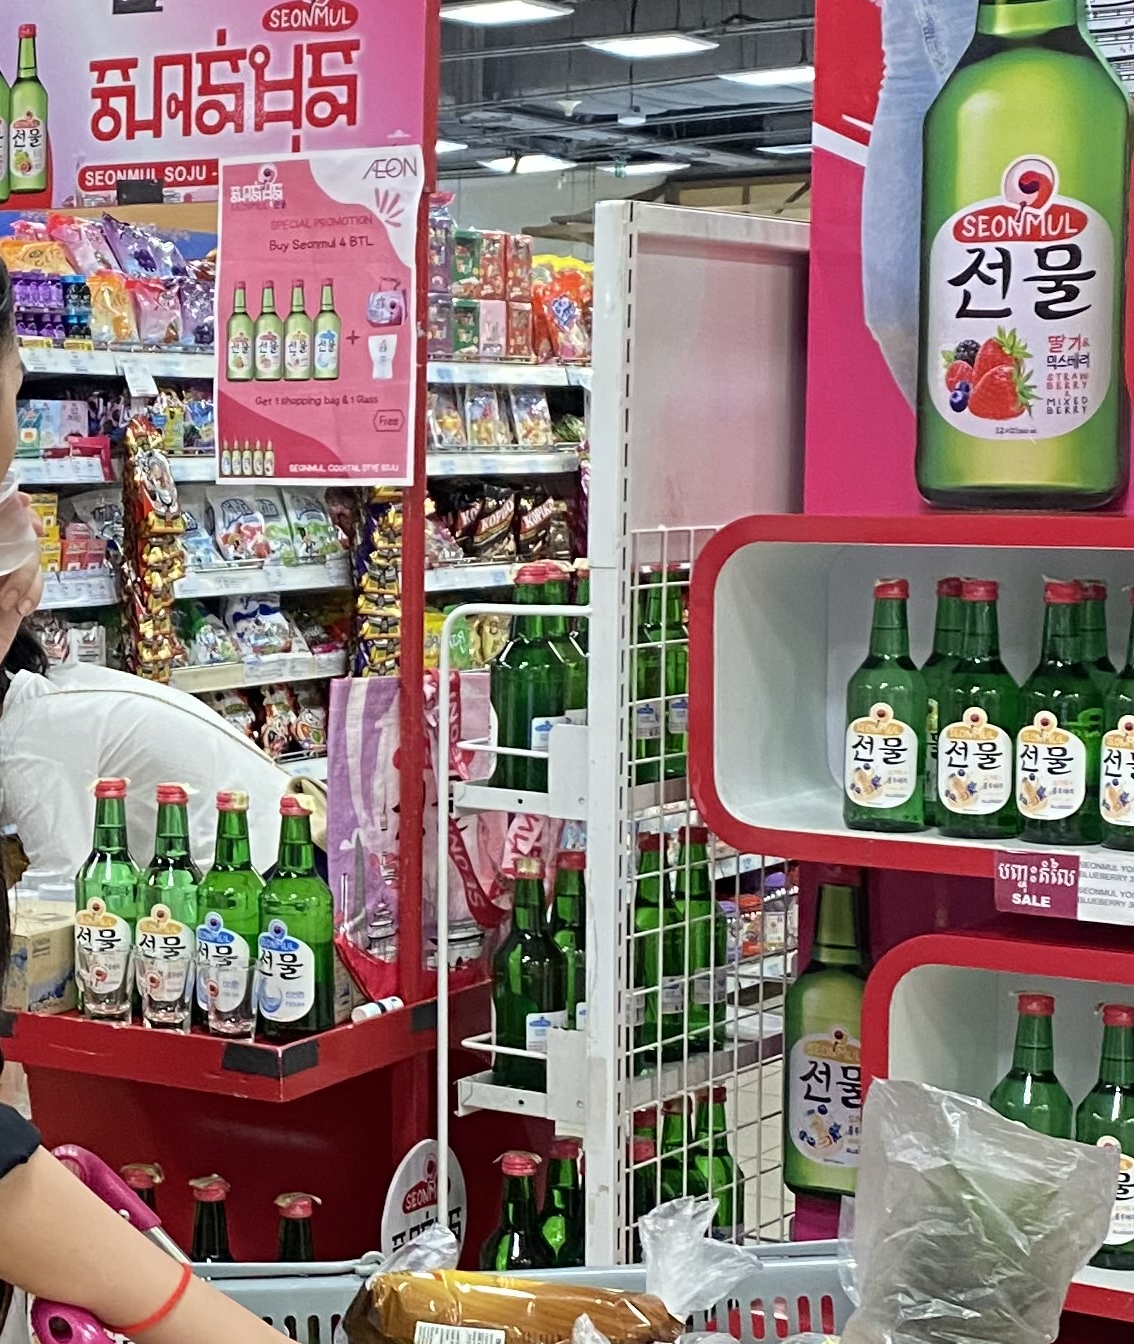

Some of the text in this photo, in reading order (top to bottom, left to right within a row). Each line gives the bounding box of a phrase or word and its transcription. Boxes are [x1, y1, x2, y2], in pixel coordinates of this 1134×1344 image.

[269, 7, 351, 28] SEONMUL
[165, 164, 207, 183] SOJU
[962, 215, 1078, 237] SEONMUL
[269, 239, 289, 253] Buy
[350, 235, 374, 248] BTL
[947, 244, 1097, 320] 선물
[1047, 373, 1089, 382] STRAW
[1047, 381, 1087, 390] BERRY
[1047, 397, 1089, 406] MIXED
[1047, 406, 1087, 414] BERRY
[379, 415, 399, 426] Free
[851, 736, 907, 765] 선물
[945, 741, 1003, 770] 선물
[1019, 745, 1074, 775] 선물
[1011, 893, 1051, 908] SALE
[259, 949, 303, 979] 선물
[800, 1060, 862, 1108] 선물
